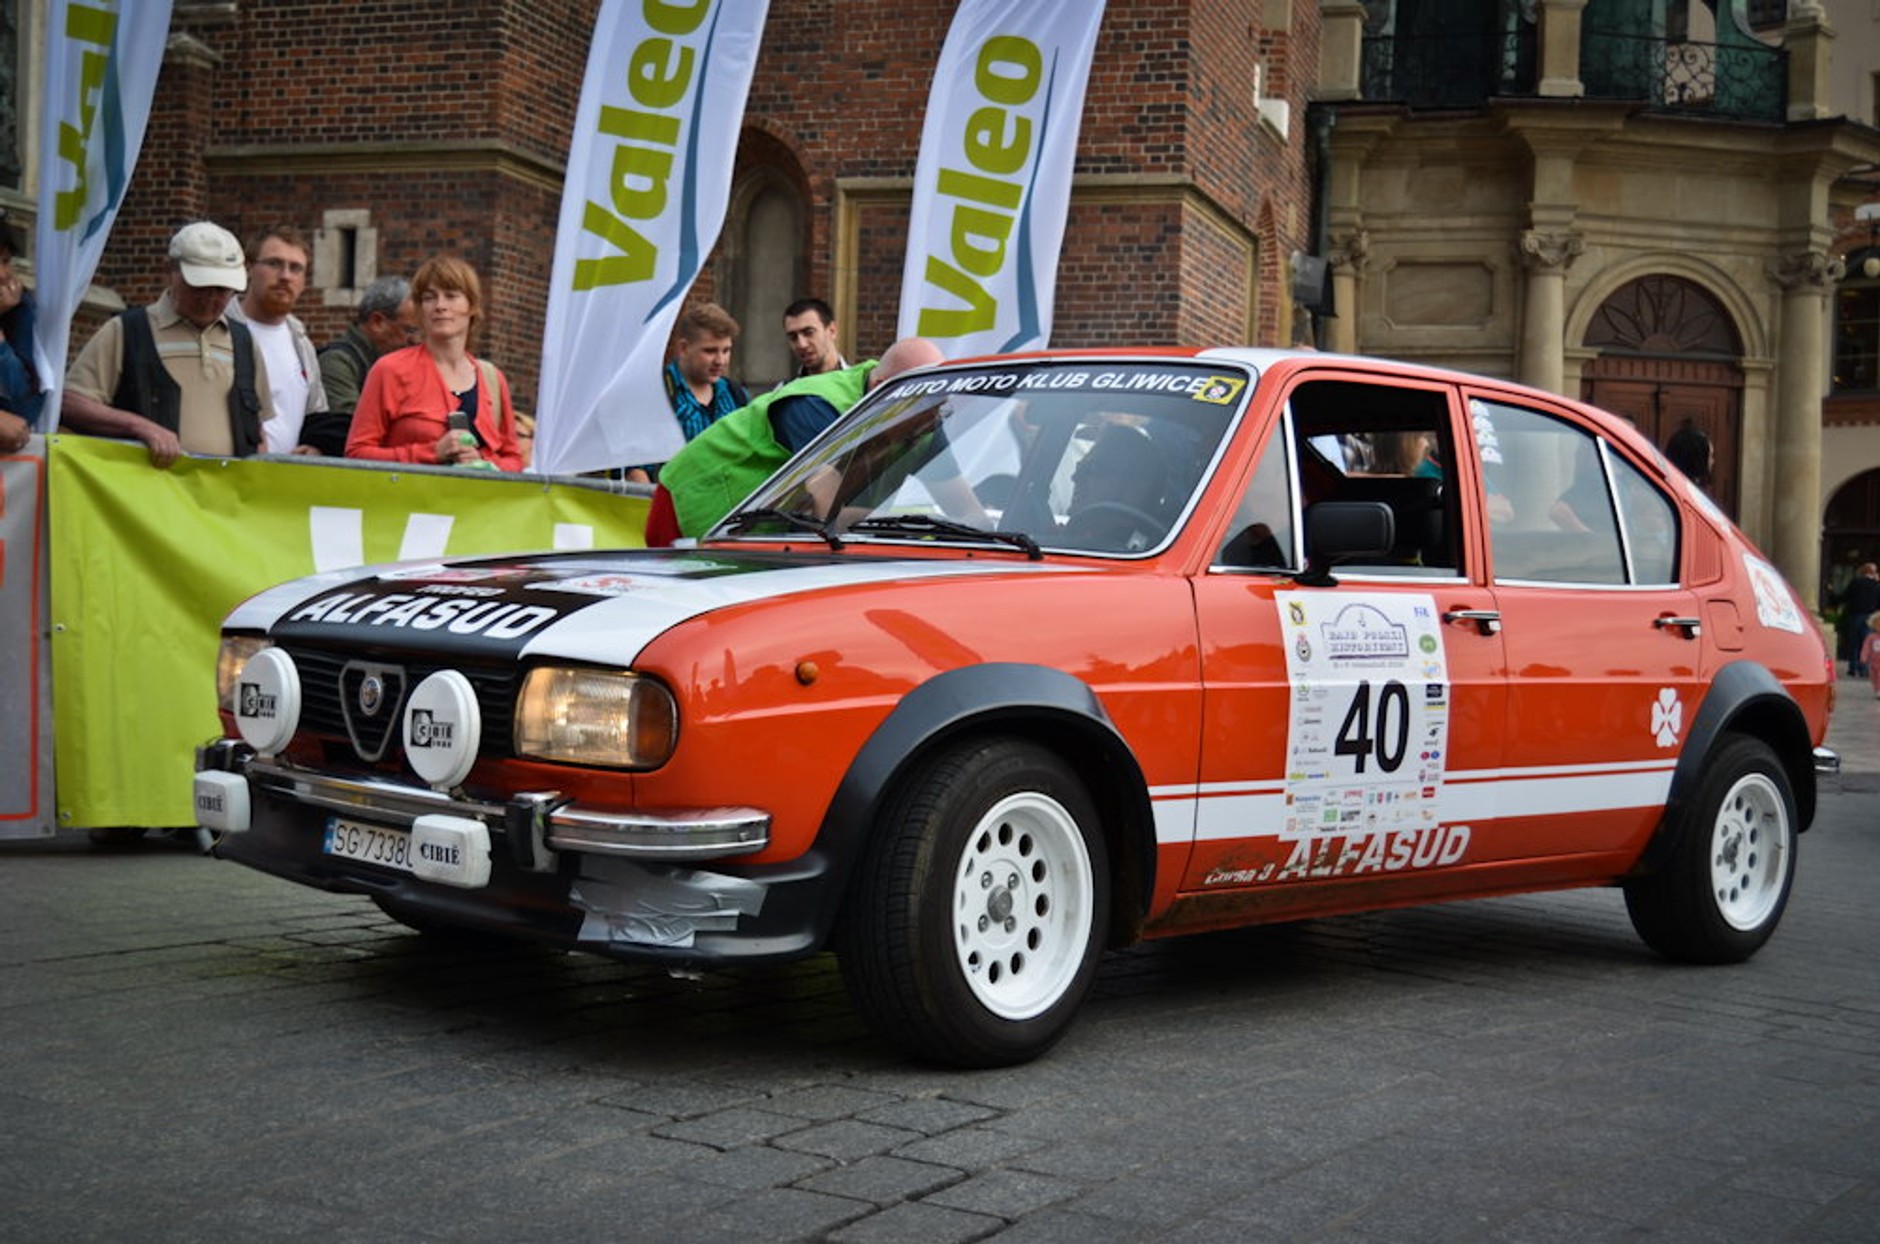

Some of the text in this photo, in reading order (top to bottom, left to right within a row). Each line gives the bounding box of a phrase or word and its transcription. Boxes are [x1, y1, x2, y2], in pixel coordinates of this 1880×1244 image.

[571, 0, 711, 291] Valeo
[917, 35, 1042, 337] Valeo
[886, 372, 1209, 400] AUTO MOTO KLUB GLIWICE
[289, 593, 558, 639] ALFASUD
[1334, 679, 1410, 774] 40
[335, 824, 359, 855] SG
[1277, 825, 1471, 880] ALFASUD
